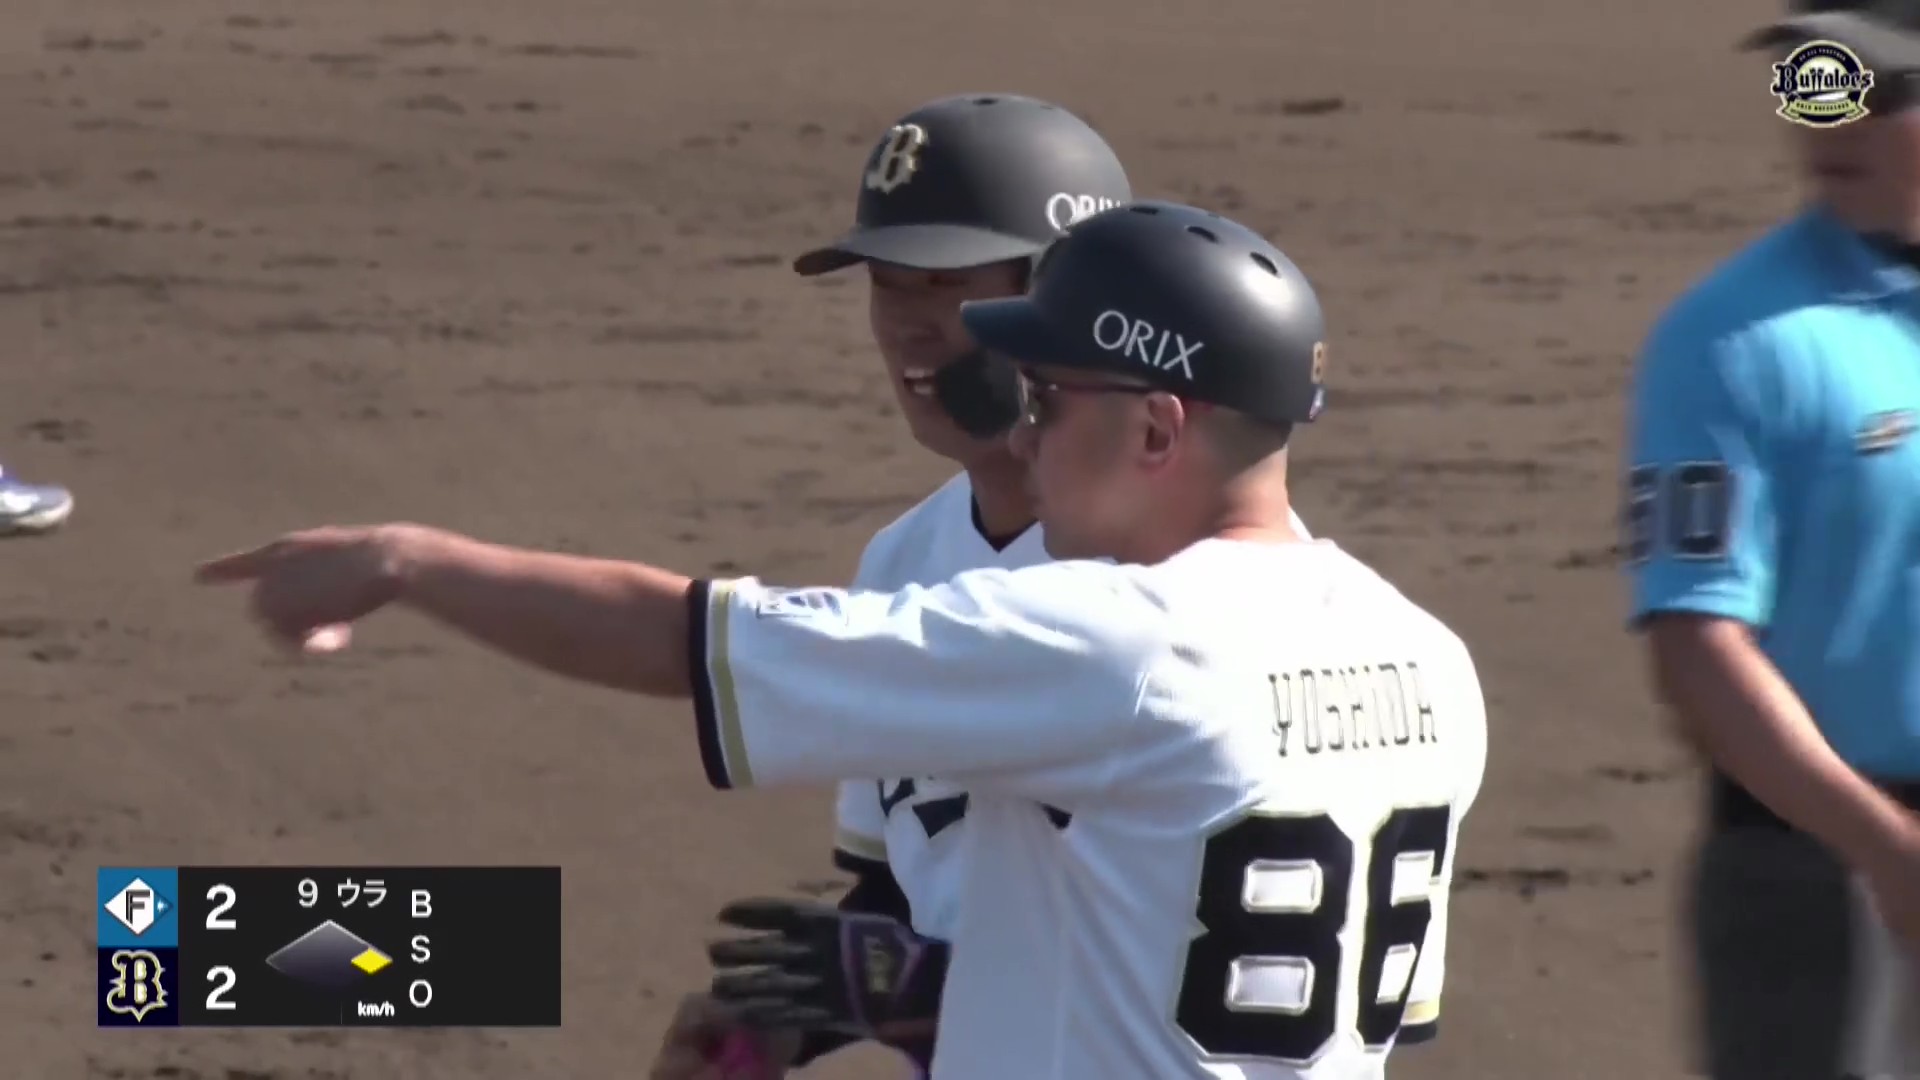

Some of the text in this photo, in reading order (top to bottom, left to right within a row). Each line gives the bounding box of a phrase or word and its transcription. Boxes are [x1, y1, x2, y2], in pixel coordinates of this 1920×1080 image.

[1045, 191, 1120, 234] OR
[1094, 310, 1204, 380] ORIX
[1174, 802, 1453, 1063] 86
